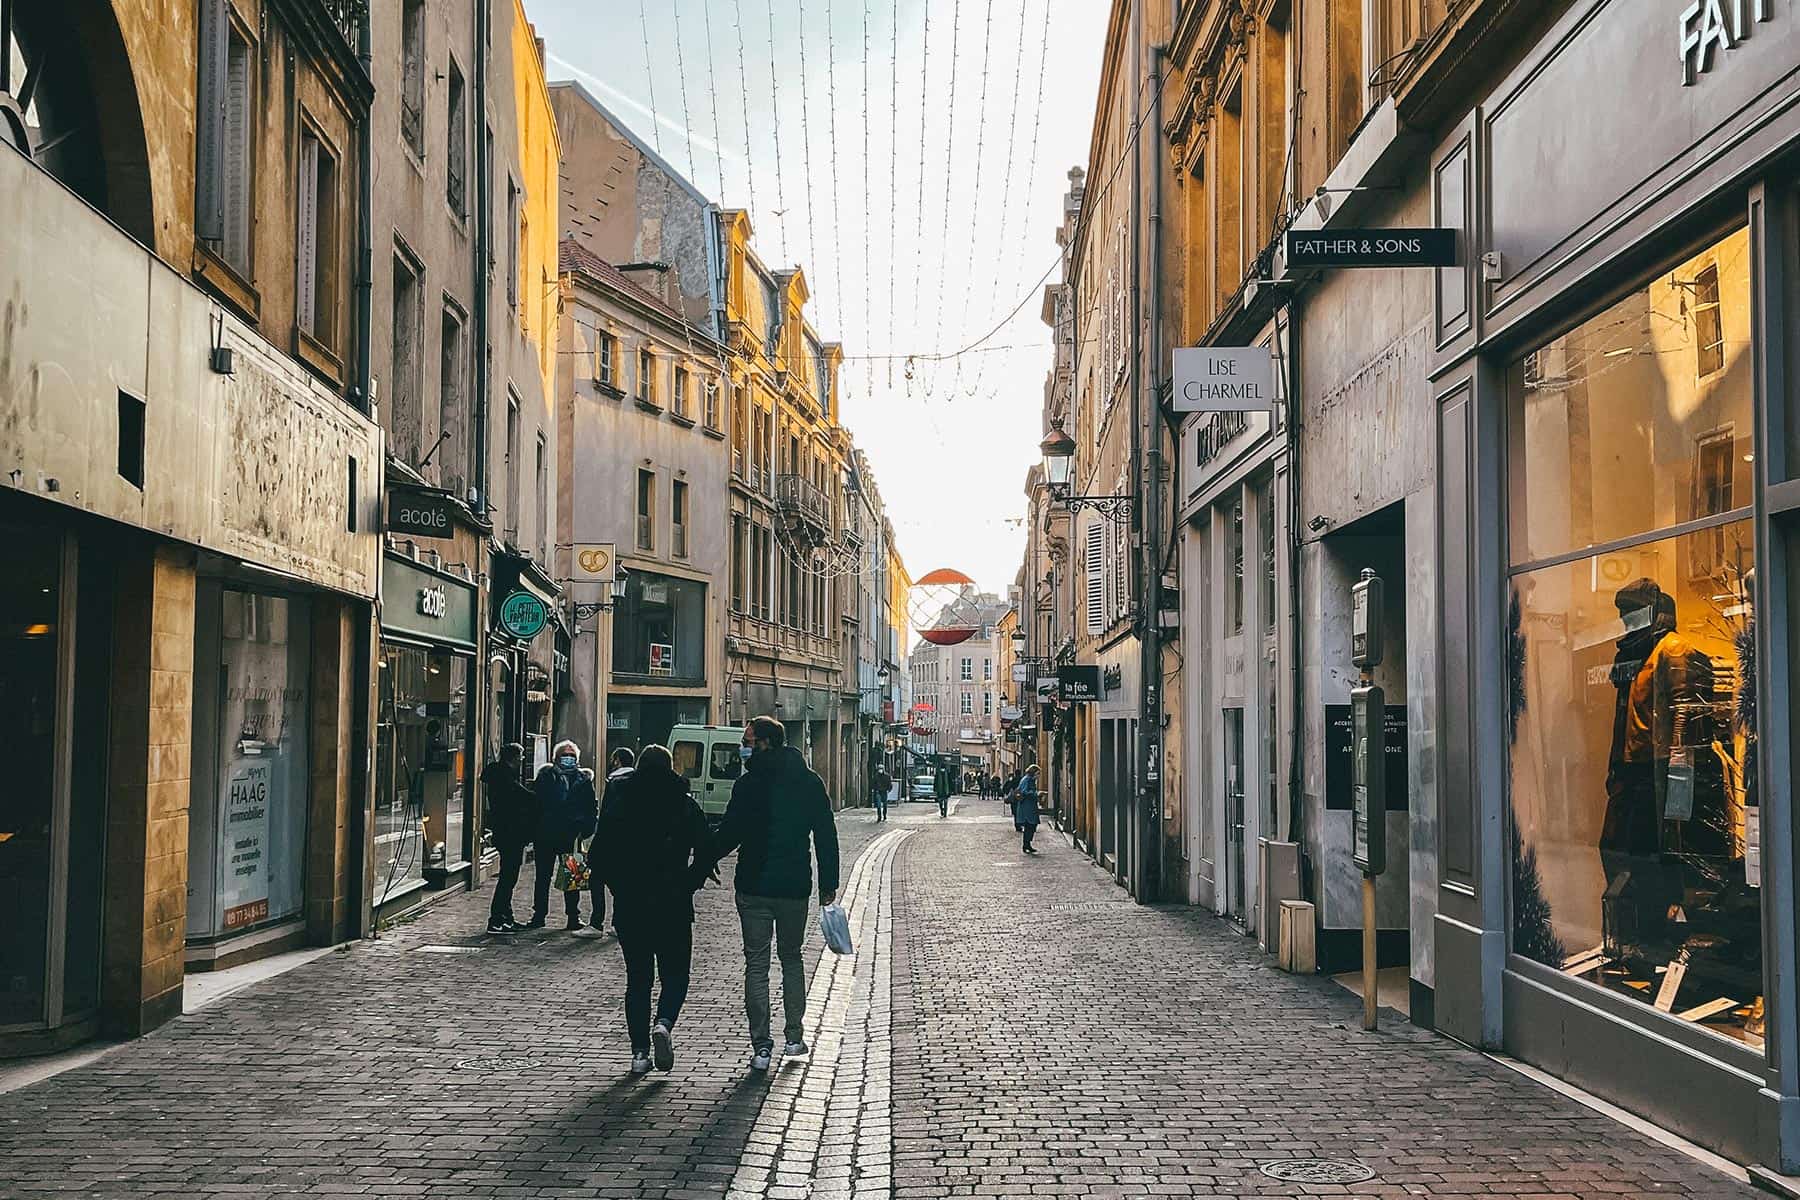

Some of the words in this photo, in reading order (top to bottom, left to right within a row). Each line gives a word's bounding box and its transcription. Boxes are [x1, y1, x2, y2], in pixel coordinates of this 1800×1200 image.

[1295, 240, 1357, 255] FATHER
[1360, 240, 1372, 254] &
[1375, 239, 1421, 253] SONS
[1208, 358, 1238, 376] LISE
[1183, 381, 1264, 401] CHARMEL
[400, 508, 447, 528] acoté
[422, 584, 446, 618] acoté
[1065, 683, 1073, 692] la
[230, 783, 266, 806] HAAG
